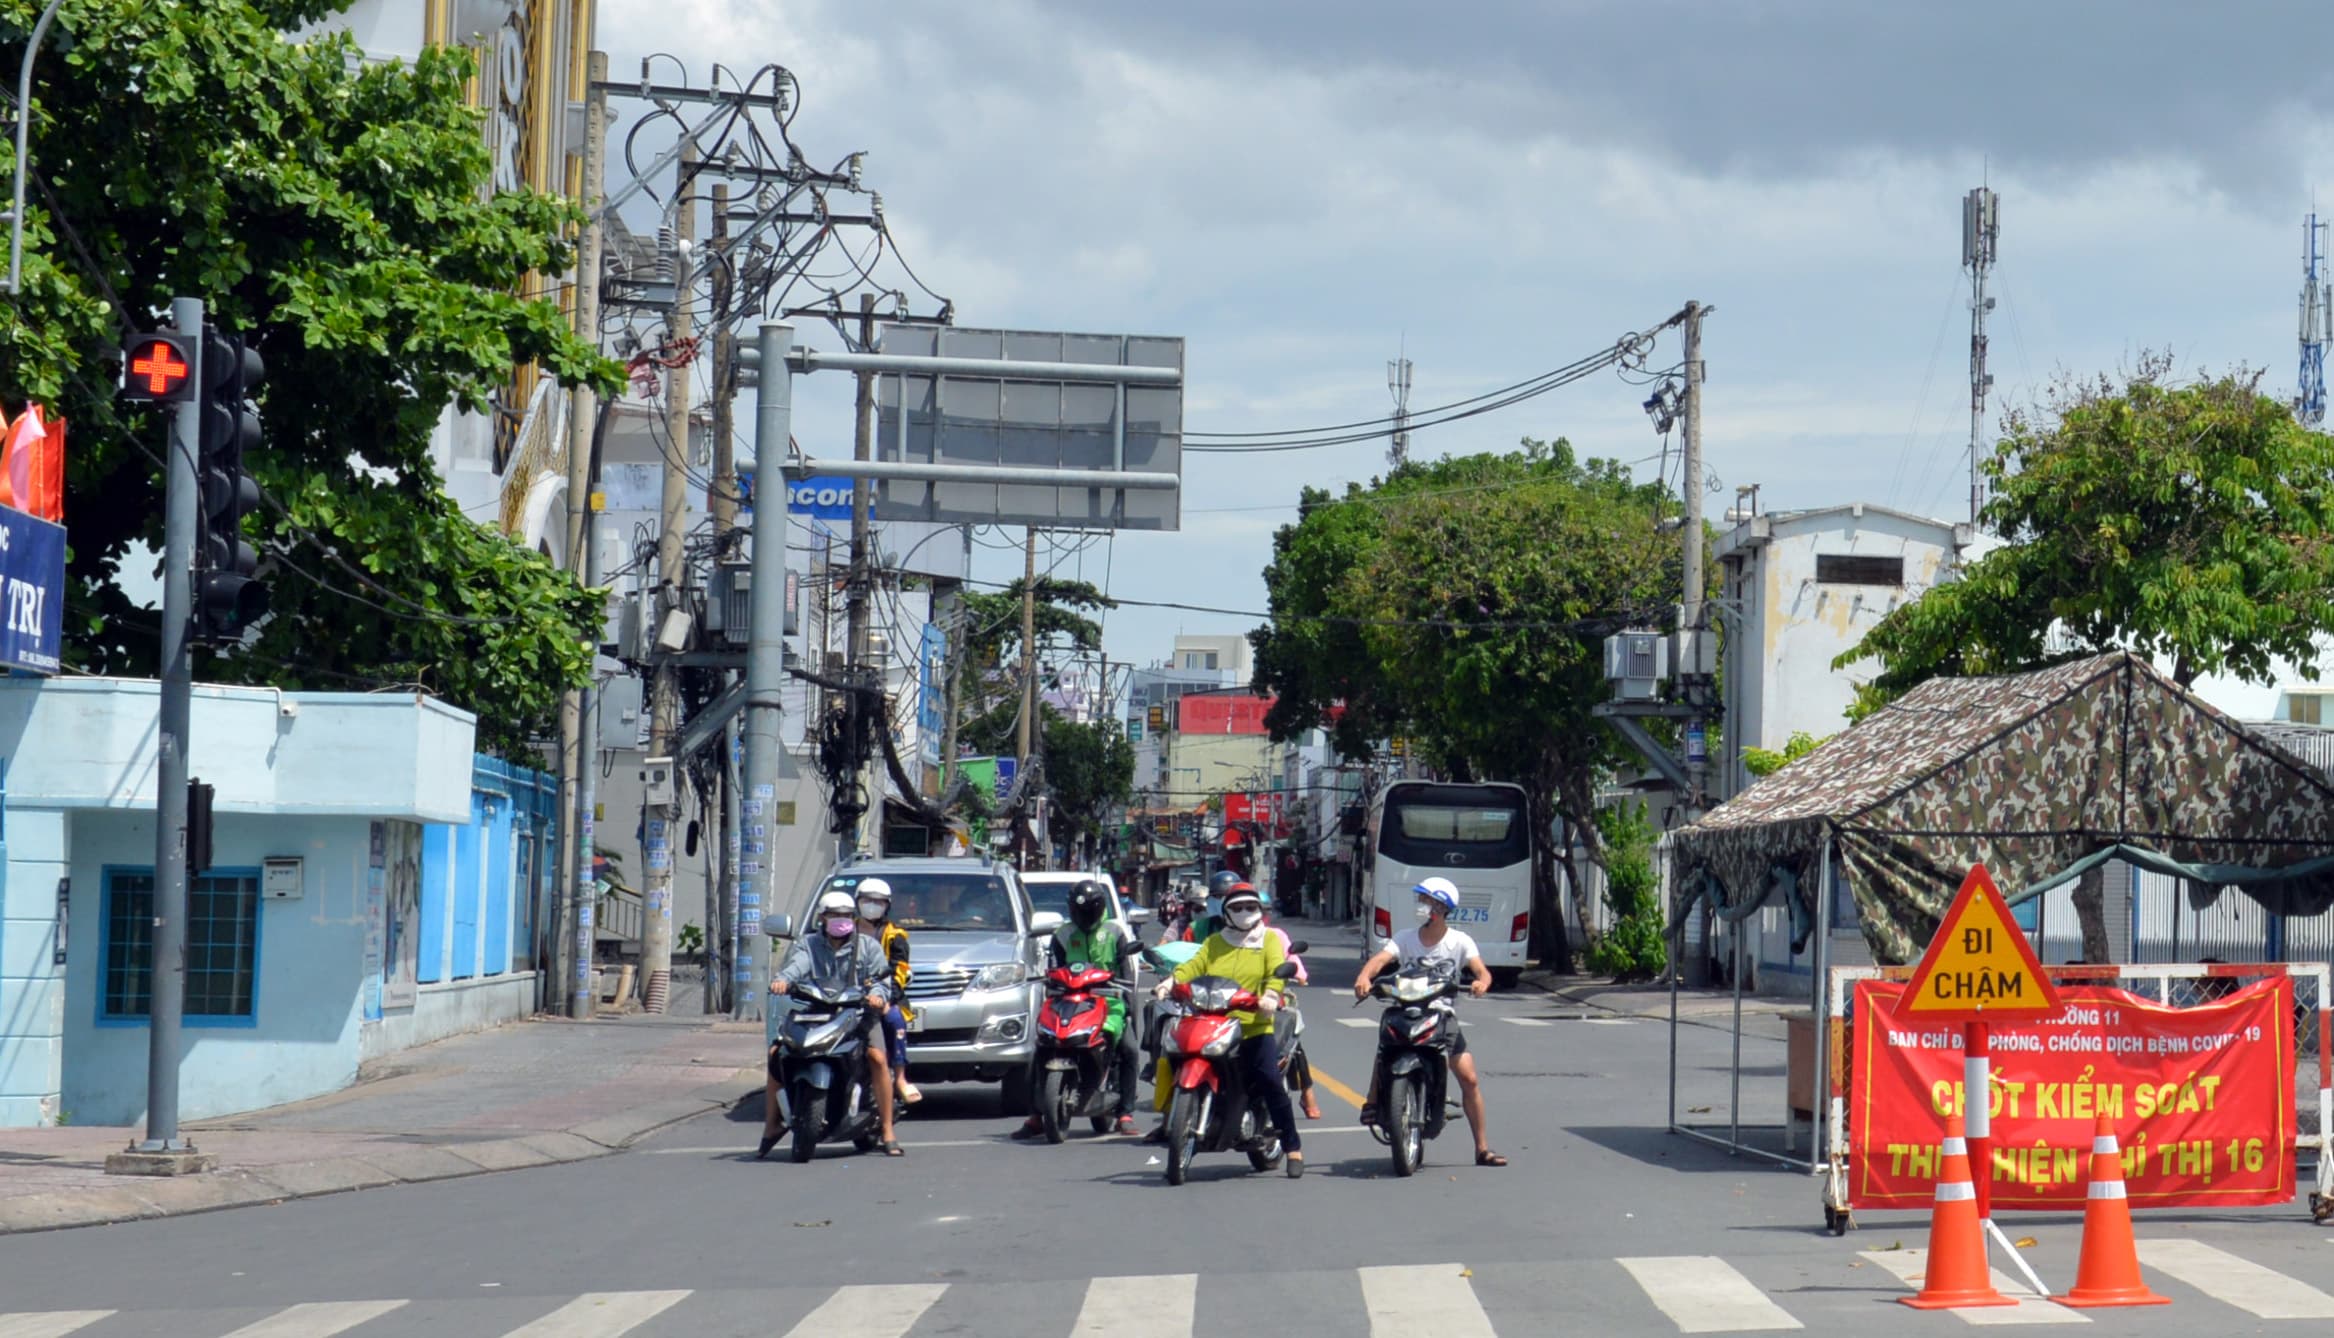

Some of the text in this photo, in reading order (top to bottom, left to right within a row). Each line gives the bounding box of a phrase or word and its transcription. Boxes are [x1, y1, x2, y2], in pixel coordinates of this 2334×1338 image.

[7, 577, 45, 649] TRỊ
[1962, 928, 1993, 954] ĐI
[1934, 966, 2022, 1003] CHẬM
[2104, 1010, 2120, 1026] 11
[1888, 1030, 1918, 1048] BAN
[1921, 1027, 1948, 1049] CHỈ
[1988, 1031, 2045, 1054] PHÒNG,
[2048, 1030, 2102, 1052] CHỐNG
[2106, 1036, 2144, 1056] DỊCH
[2147, 1035, 2188, 1056] BỆNH
[2036, 1065, 2123, 1119] KIỂM
[2135, 1071, 2221, 1119] SOÁT
[1992, 1139, 2077, 1194] HIỆN
[2088, 1131, 2147, 1179] HỈ
[2157, 1139, 2213, 1184] THỊ
[2226, 1137, 2264, 1173] 16
